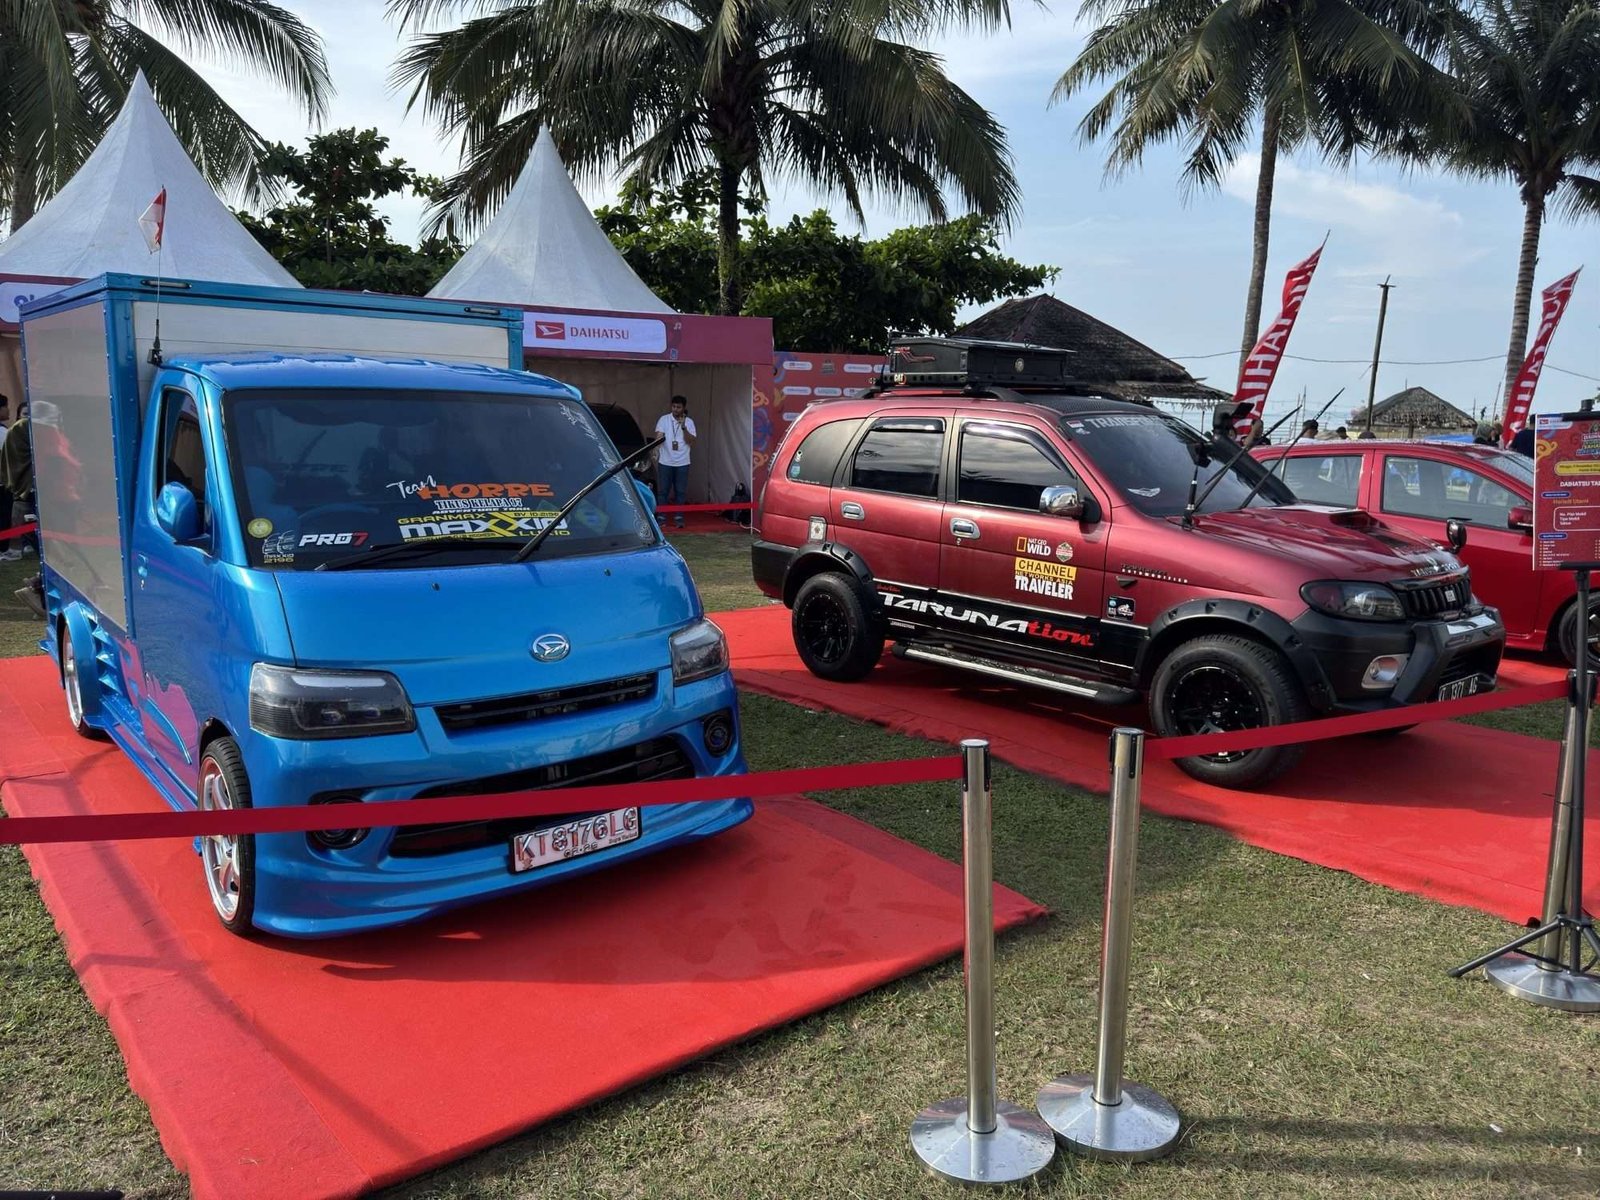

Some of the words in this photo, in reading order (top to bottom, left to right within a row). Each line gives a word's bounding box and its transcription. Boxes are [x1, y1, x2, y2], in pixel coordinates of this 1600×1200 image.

[570, 326, 630, 340] DAIHATSU
[386, 474, 437, 499] Team
[417, 483, 554, 499] HORRE
[433, 499, 470, 511] TIKUS
[470, 498, 511, 509] KELAPA
[398, 513, 487, 524] GRANMAX
[298, 532, 369, 546] PRO7
[1027, 543, 1051, 556] WILD
[1018, 559, 1074, 578] CHANNEL
[1015, 574, 1073, 600] TRAVELER
[515, 830, 549, 861] KT
[551, 816, 608, 851] 8176
[609, 808, 637, 837] LG
